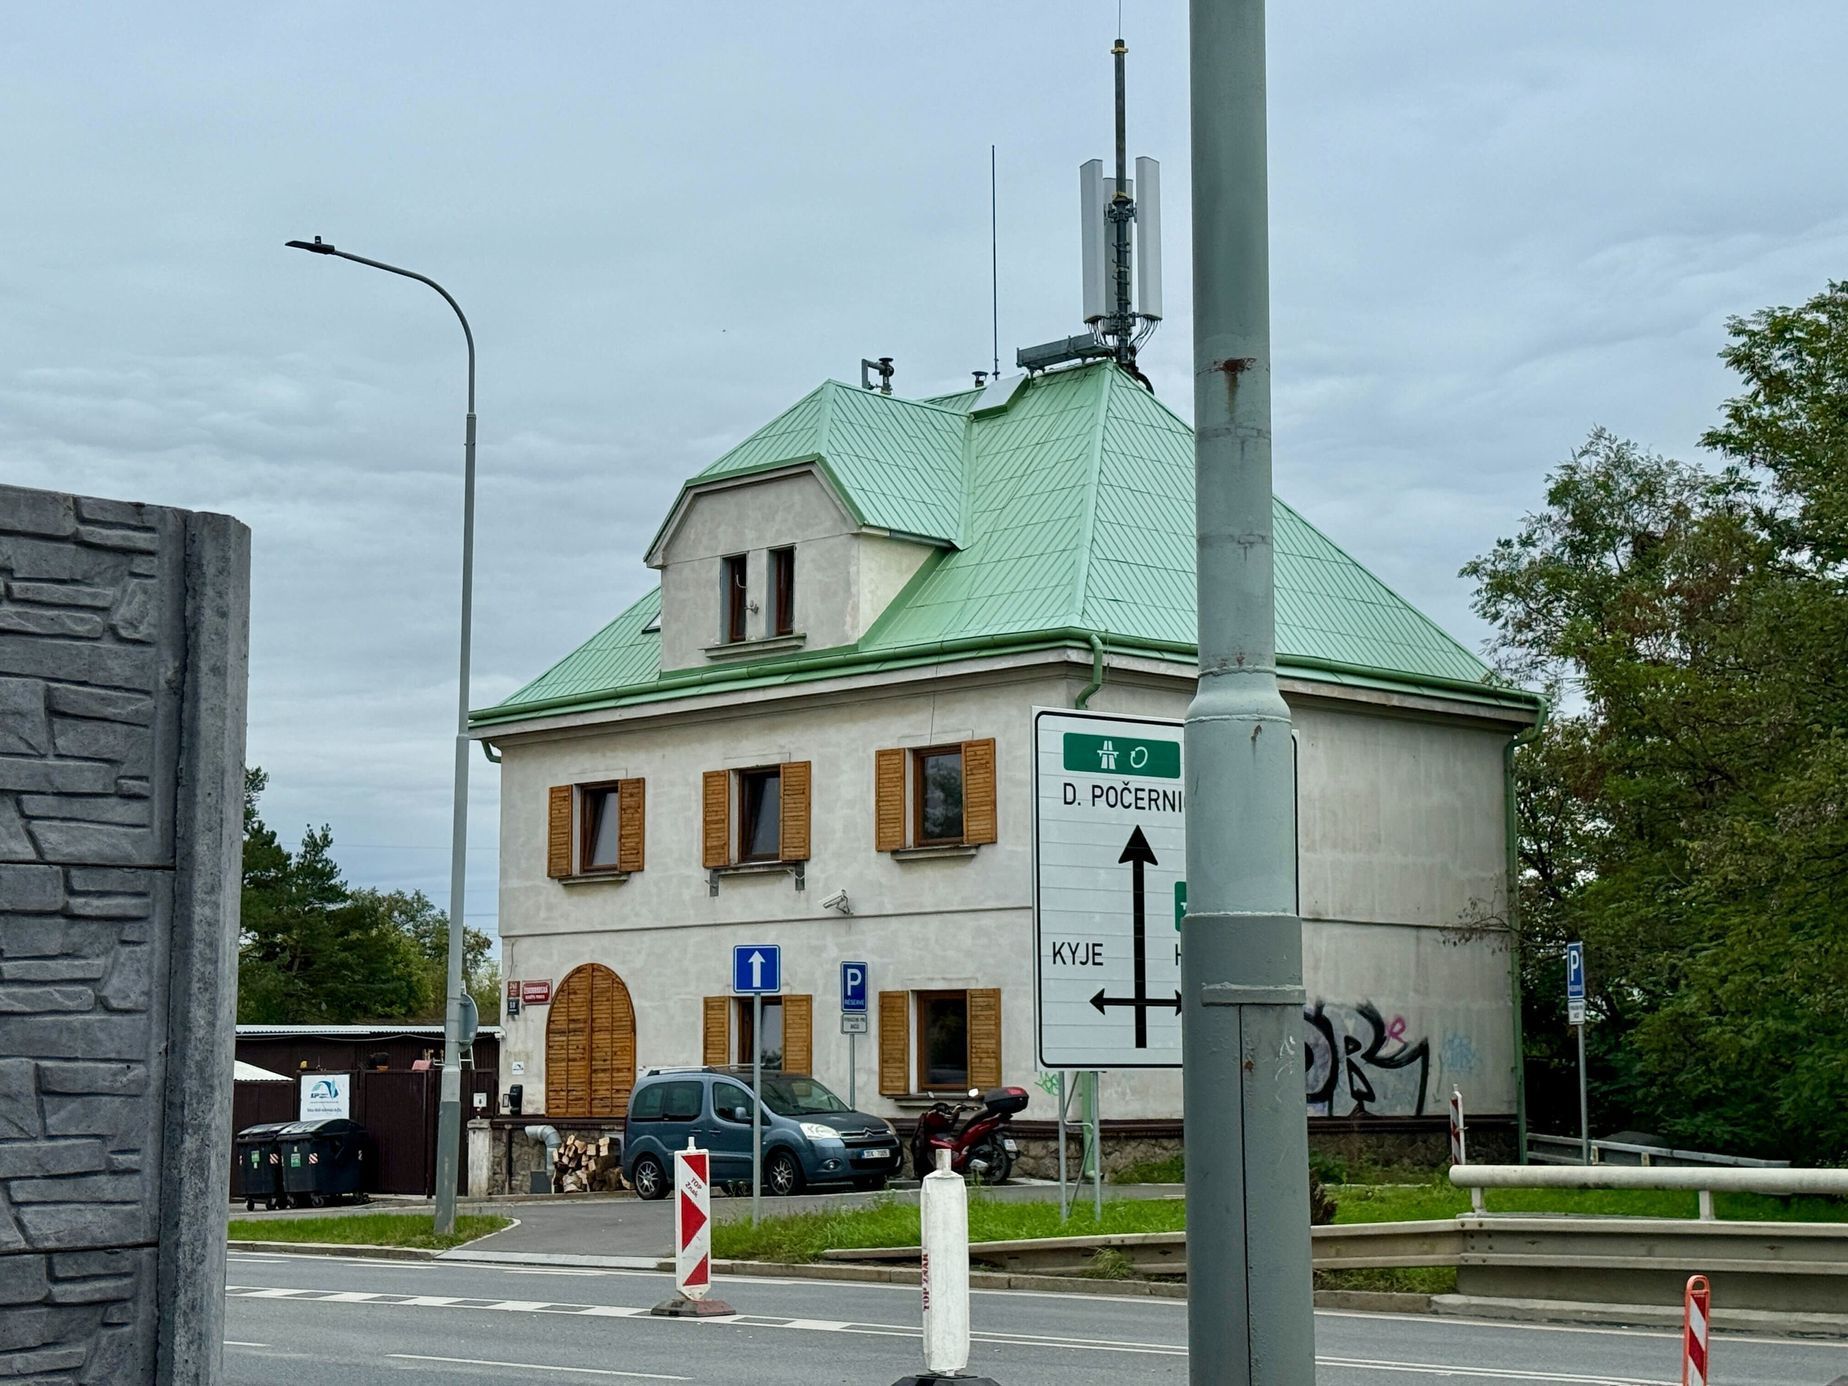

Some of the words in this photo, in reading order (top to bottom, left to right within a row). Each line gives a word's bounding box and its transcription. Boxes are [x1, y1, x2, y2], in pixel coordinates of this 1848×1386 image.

[1062, 782, 1082, 807] D.
[1091, 781, 1182, 813] POČERNI
[1052, 941, 1104, 967] KYJE
[1570, 950, 1579, 982] P
[847, 968, 862, 996] P
[690, 1176, 703, 1190] TOP
